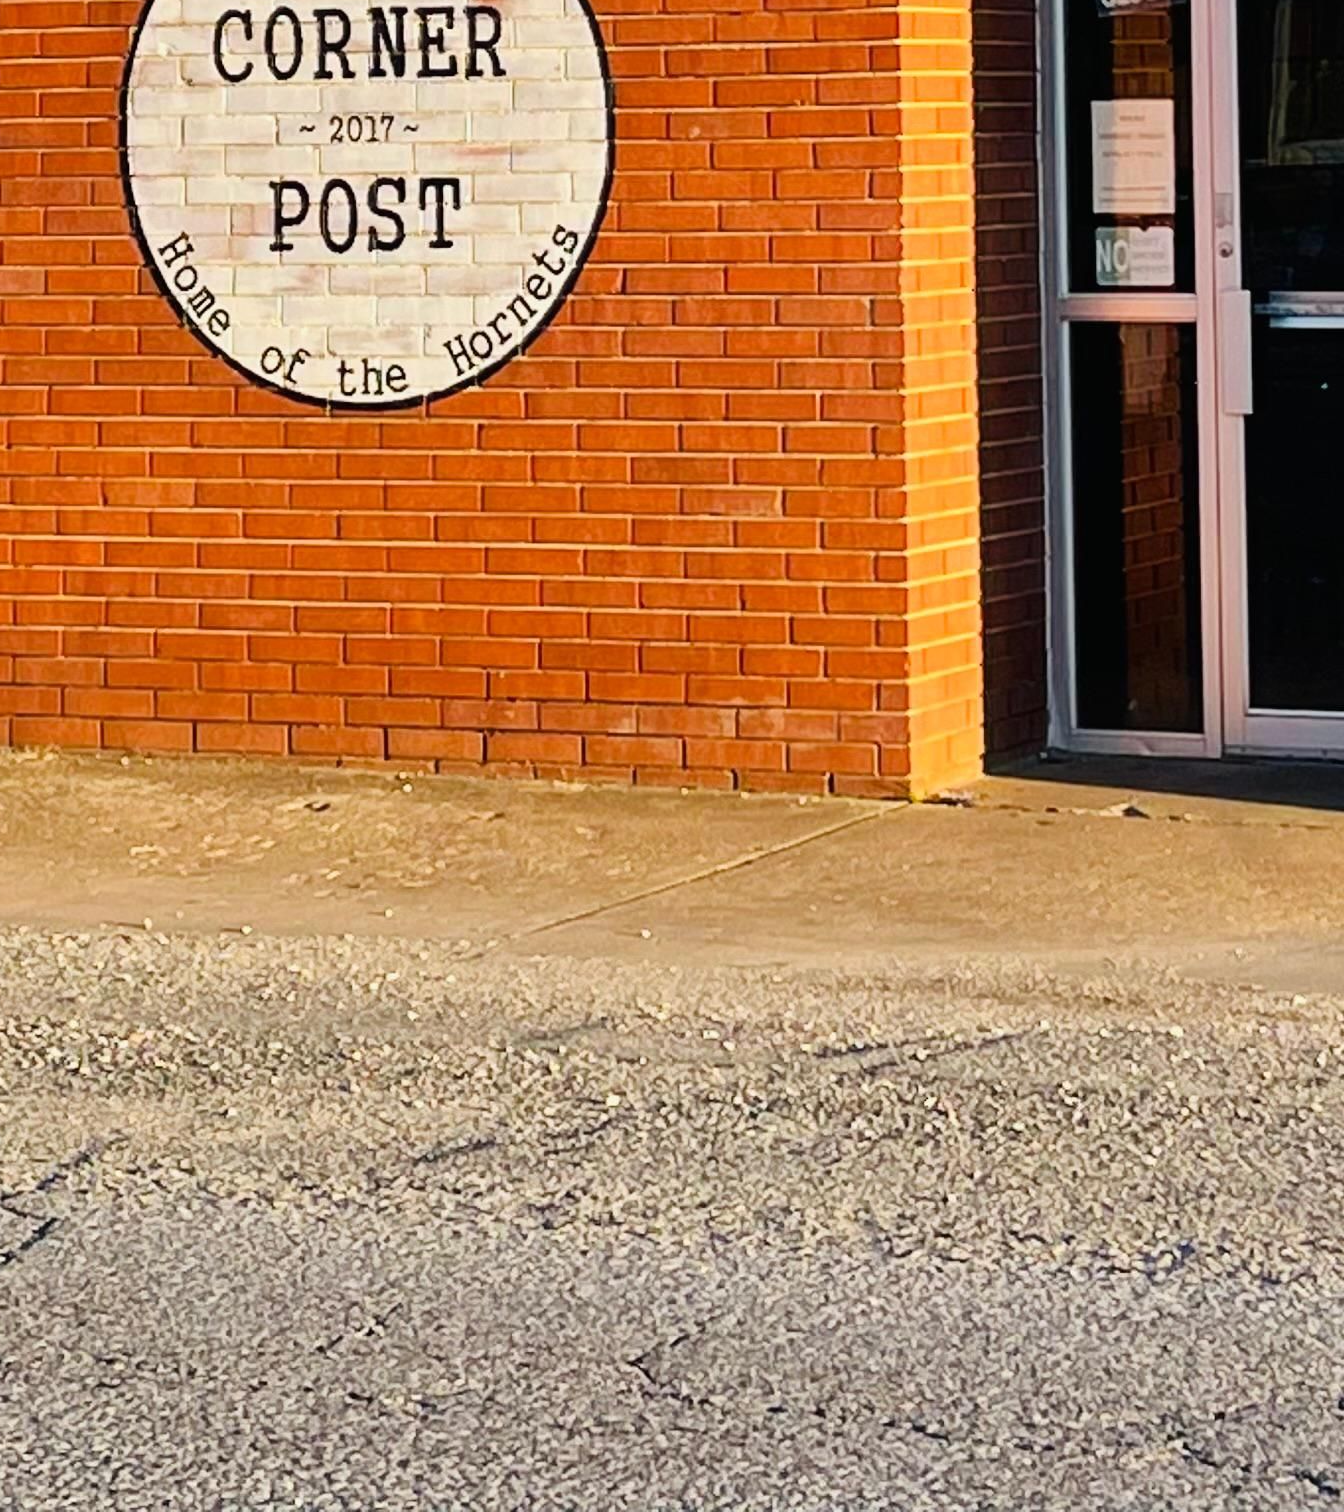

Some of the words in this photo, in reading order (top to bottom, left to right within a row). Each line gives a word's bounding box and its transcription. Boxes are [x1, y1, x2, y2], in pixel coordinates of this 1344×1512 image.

[213, 6, 507, 83] CORNER
[268, 176, 461, 254] POST
[1096, 239, 1129, 273] NO
[158, 231, 232, 338] Home
[260, 343, 311, 387] of
[337, 359, 408, 396] the
[442, 223, 580, 376] Hornets
